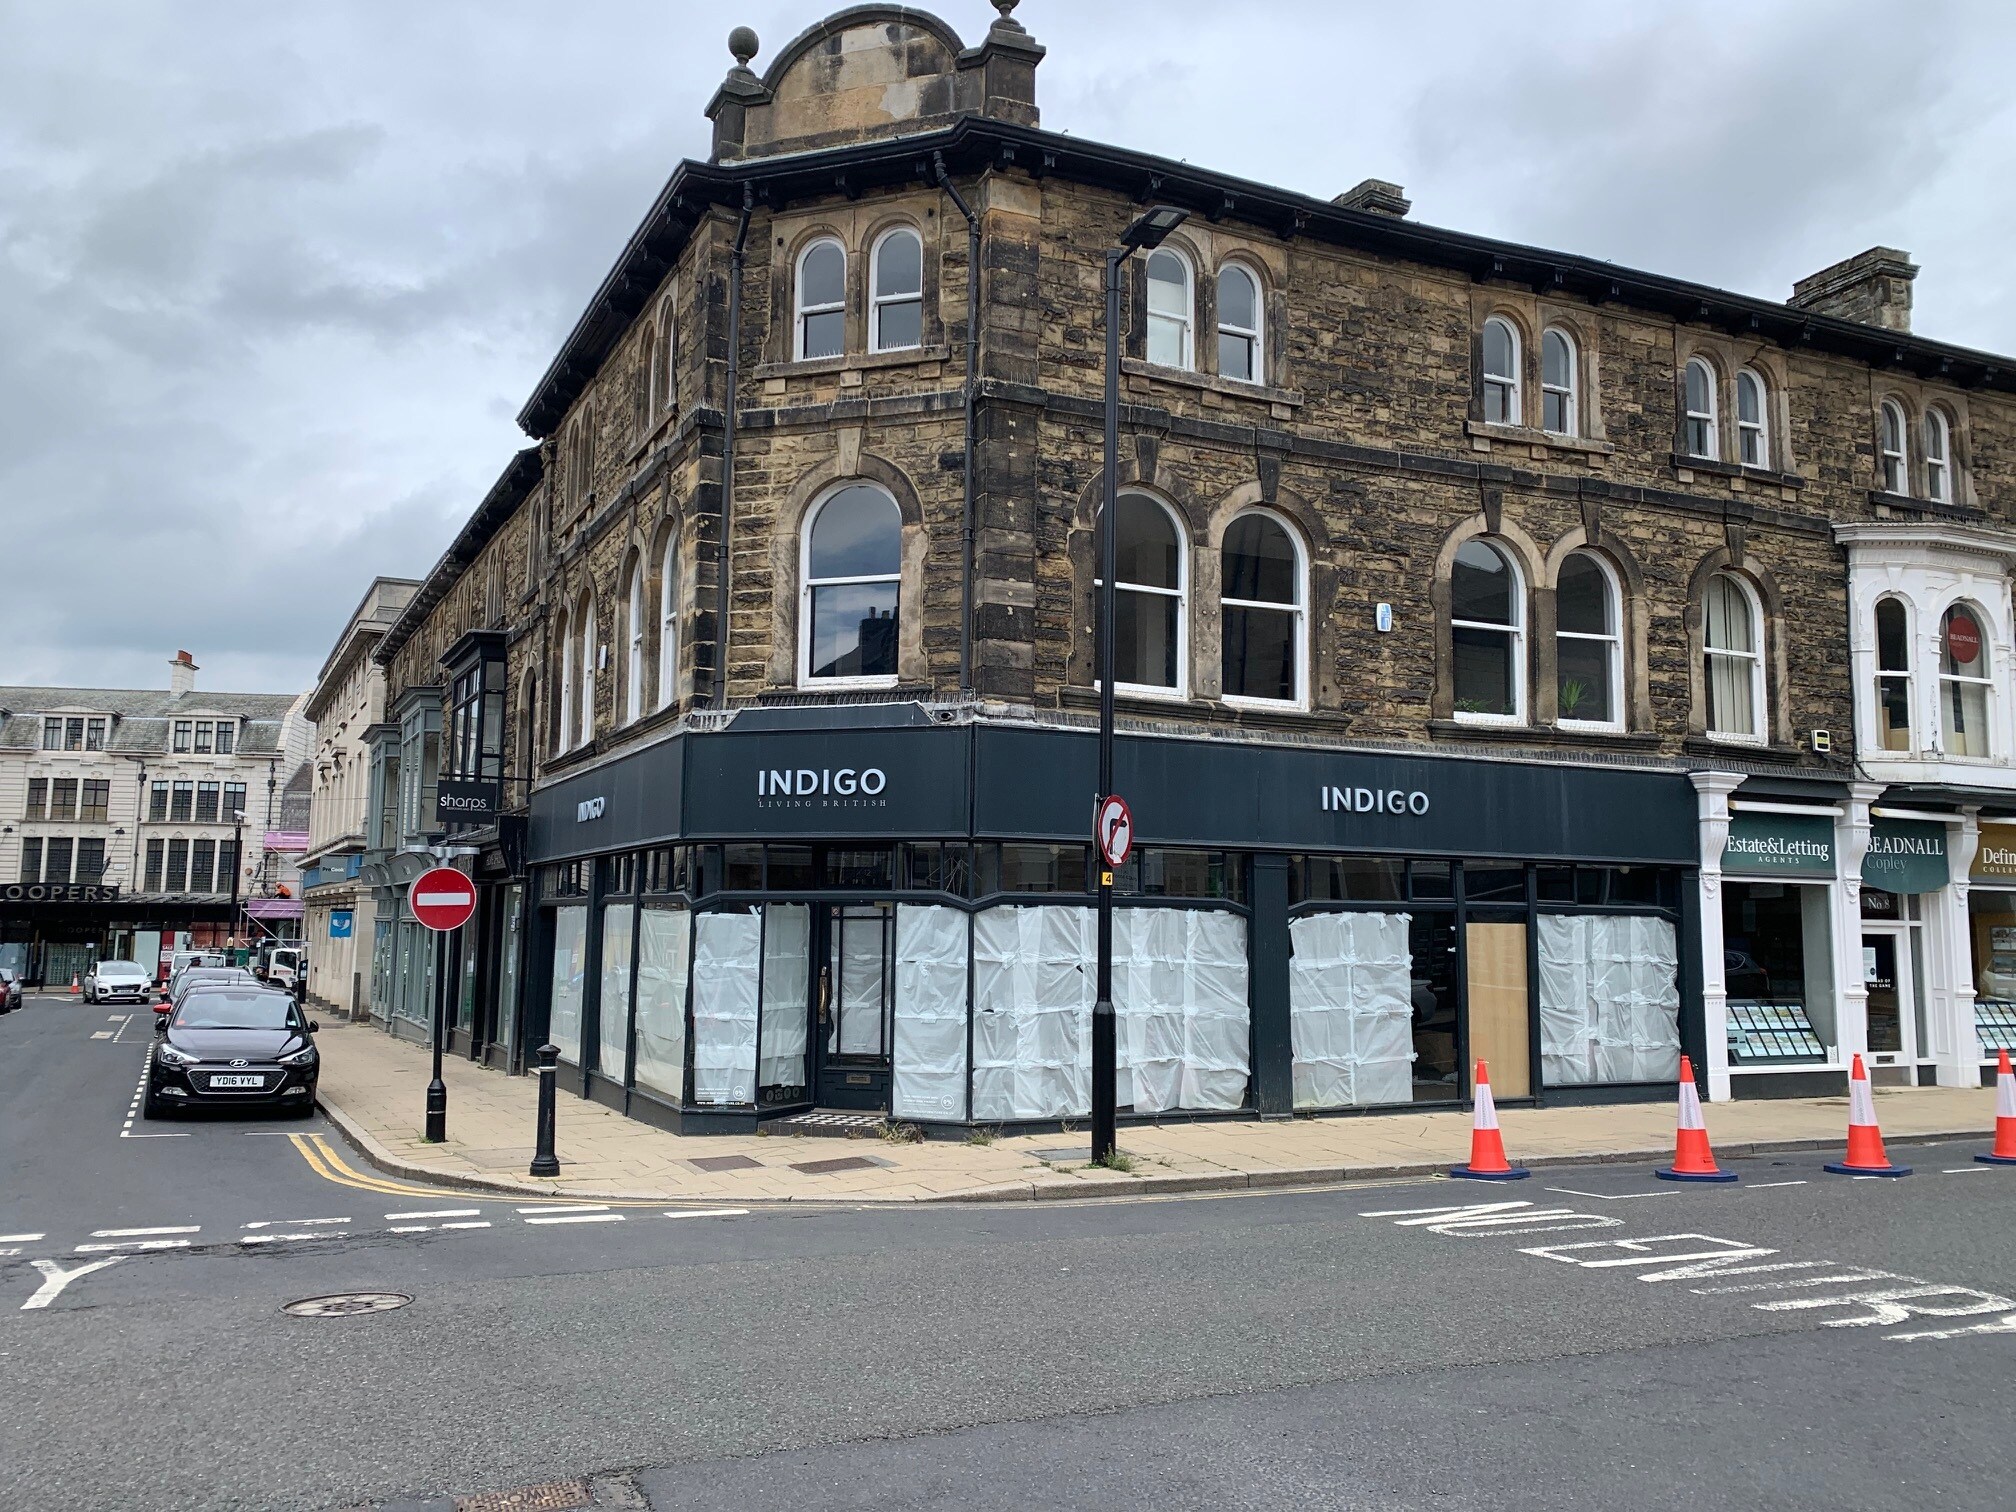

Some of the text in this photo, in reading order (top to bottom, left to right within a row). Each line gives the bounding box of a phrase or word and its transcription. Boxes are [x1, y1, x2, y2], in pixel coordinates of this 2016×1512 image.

[758, 768, 887, 796] INDIGO
[439, 793, 487, 812] sharps
[577, 796, 605, 823] INDIGO
[758, 799, 887, 808] LIVING BRITISH
[1321, 786, 1430, 816] INDIGO
[1726, 835, 1829, 861] Estate&Letting
[1758, 856, 1800, 865] AGENTS
[1866, 855, 1908, 876] Copley
[1105, 874, 1112, 884] 4
[1883, 898, 1891, 910] 8
[216, 1076, 258, 1086] YD16 VYL
